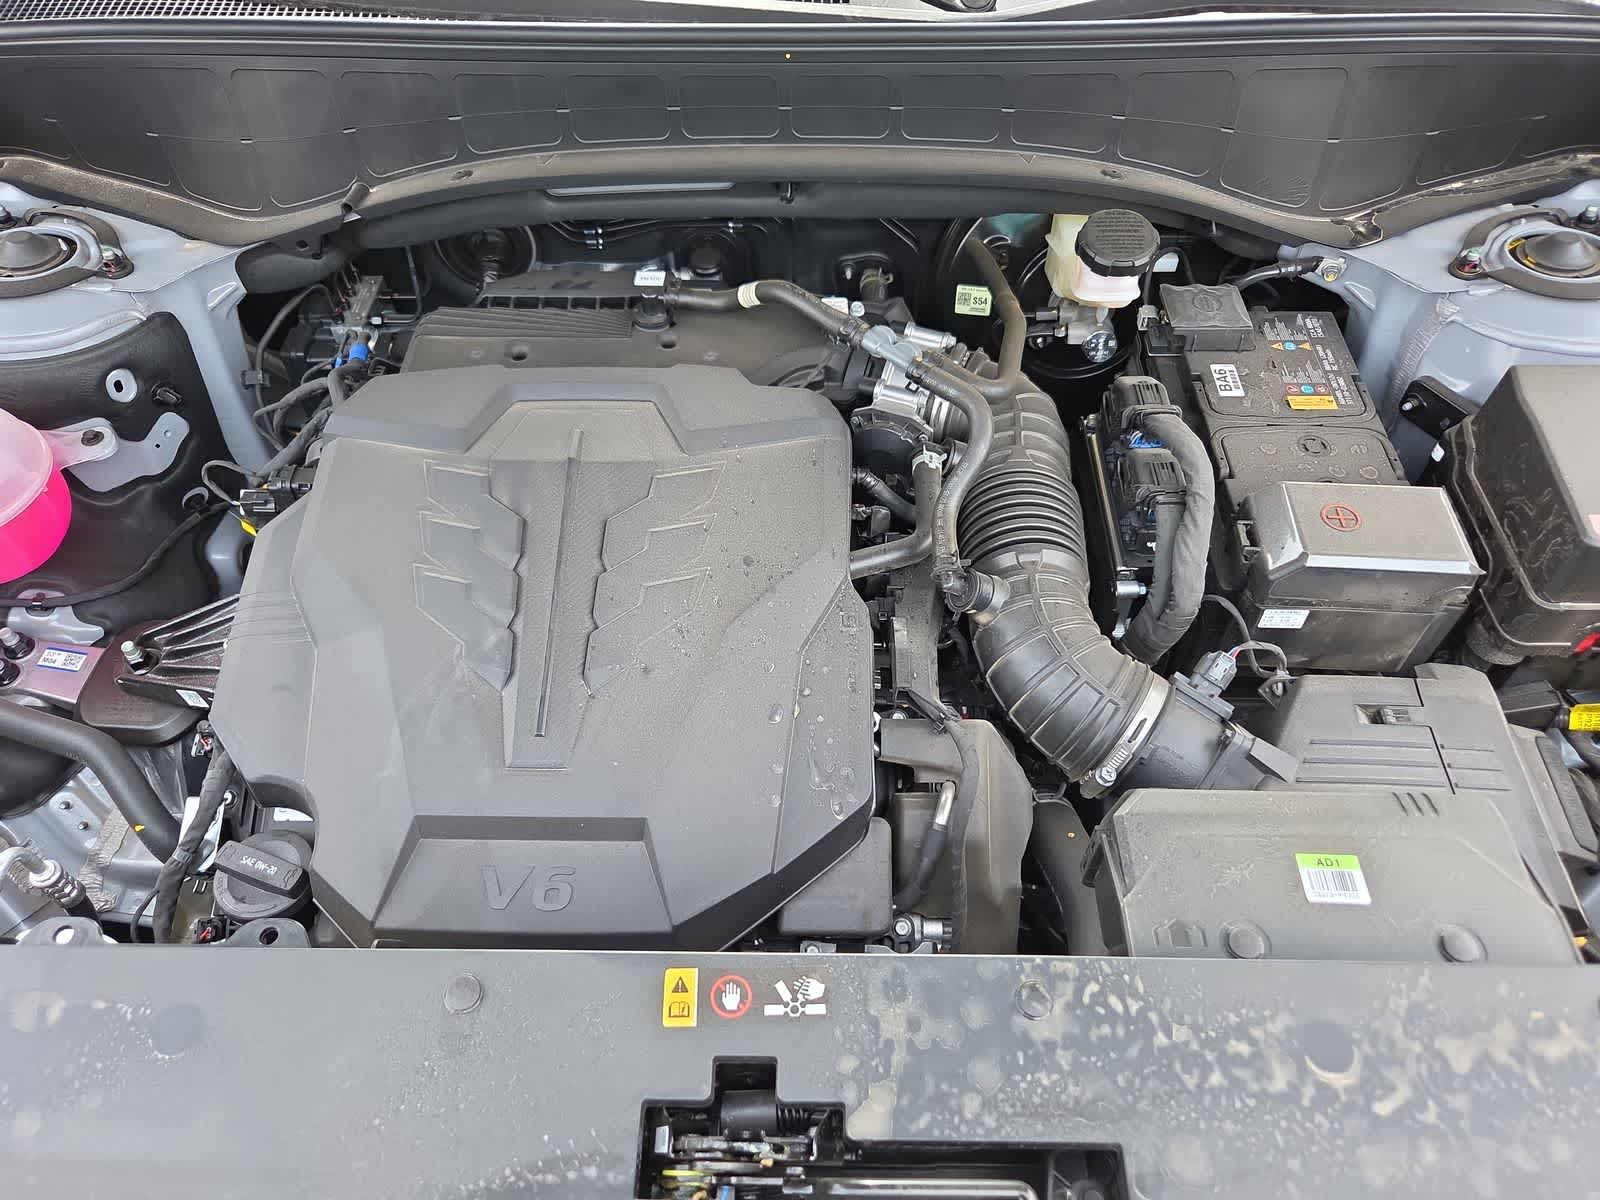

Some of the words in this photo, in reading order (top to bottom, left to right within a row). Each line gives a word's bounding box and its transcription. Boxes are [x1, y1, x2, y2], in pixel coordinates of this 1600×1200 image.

[1214, 368, 1233, 391] BA6
[240, 855, 257, 867] SAE
[254, 860, 278, 875] 0W-20
[1316, 857, 1341, 867] AD1
[480, 864, 577, 912] V6
